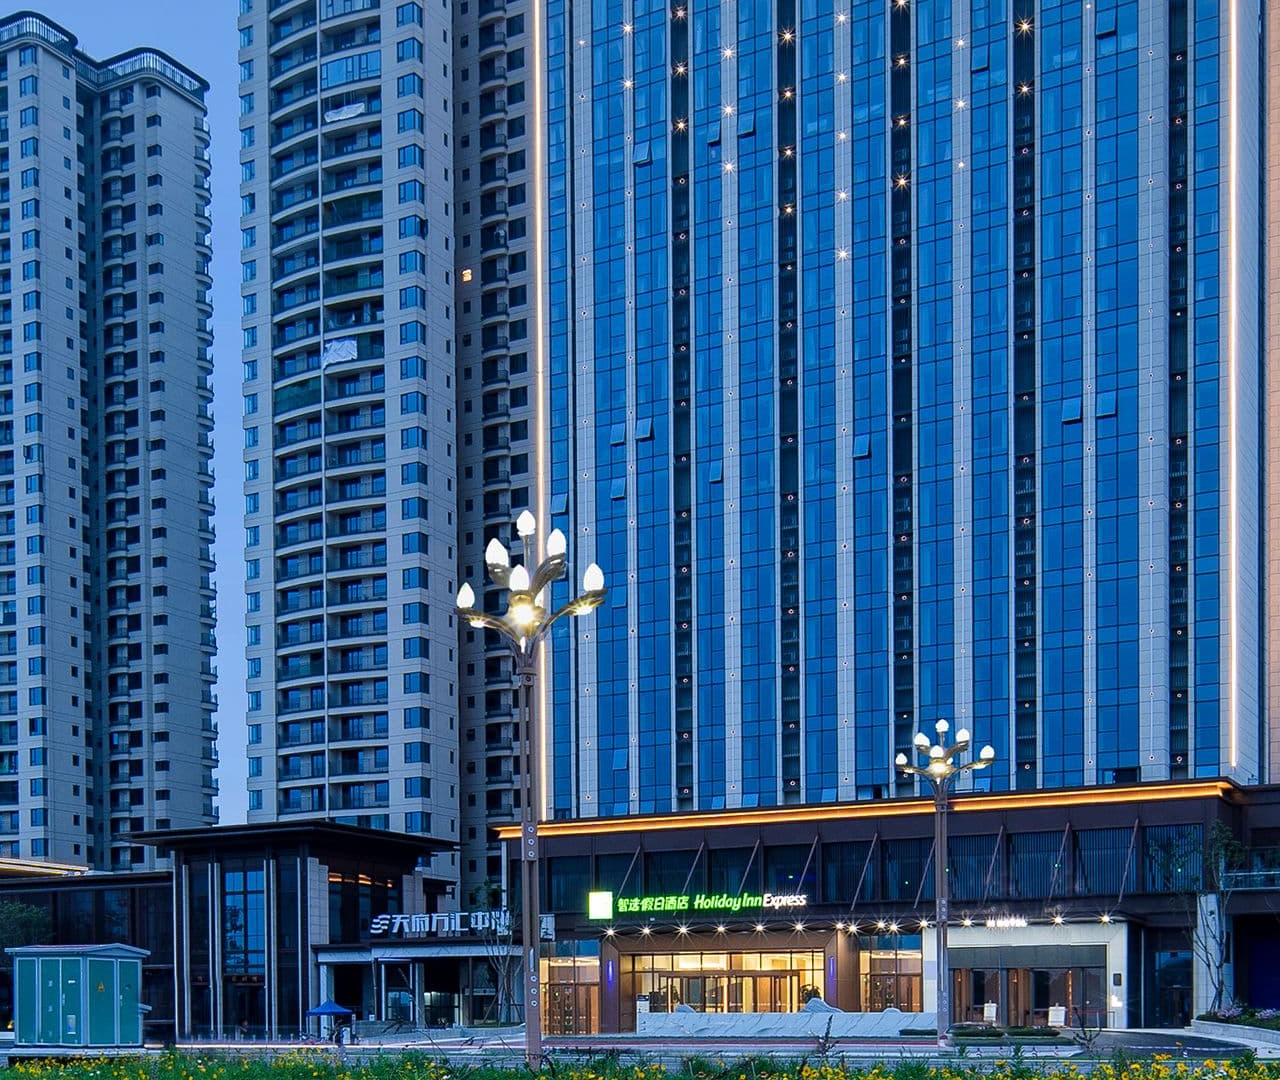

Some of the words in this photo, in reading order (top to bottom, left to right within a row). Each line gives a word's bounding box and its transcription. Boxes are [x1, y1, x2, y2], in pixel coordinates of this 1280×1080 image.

[617, 896, 689, 912] 智选假日酒店
[694, 894, 741, 910] Holiday
[742, 892, 762, 907] Inn
[763, 893, 808, 909] Express
